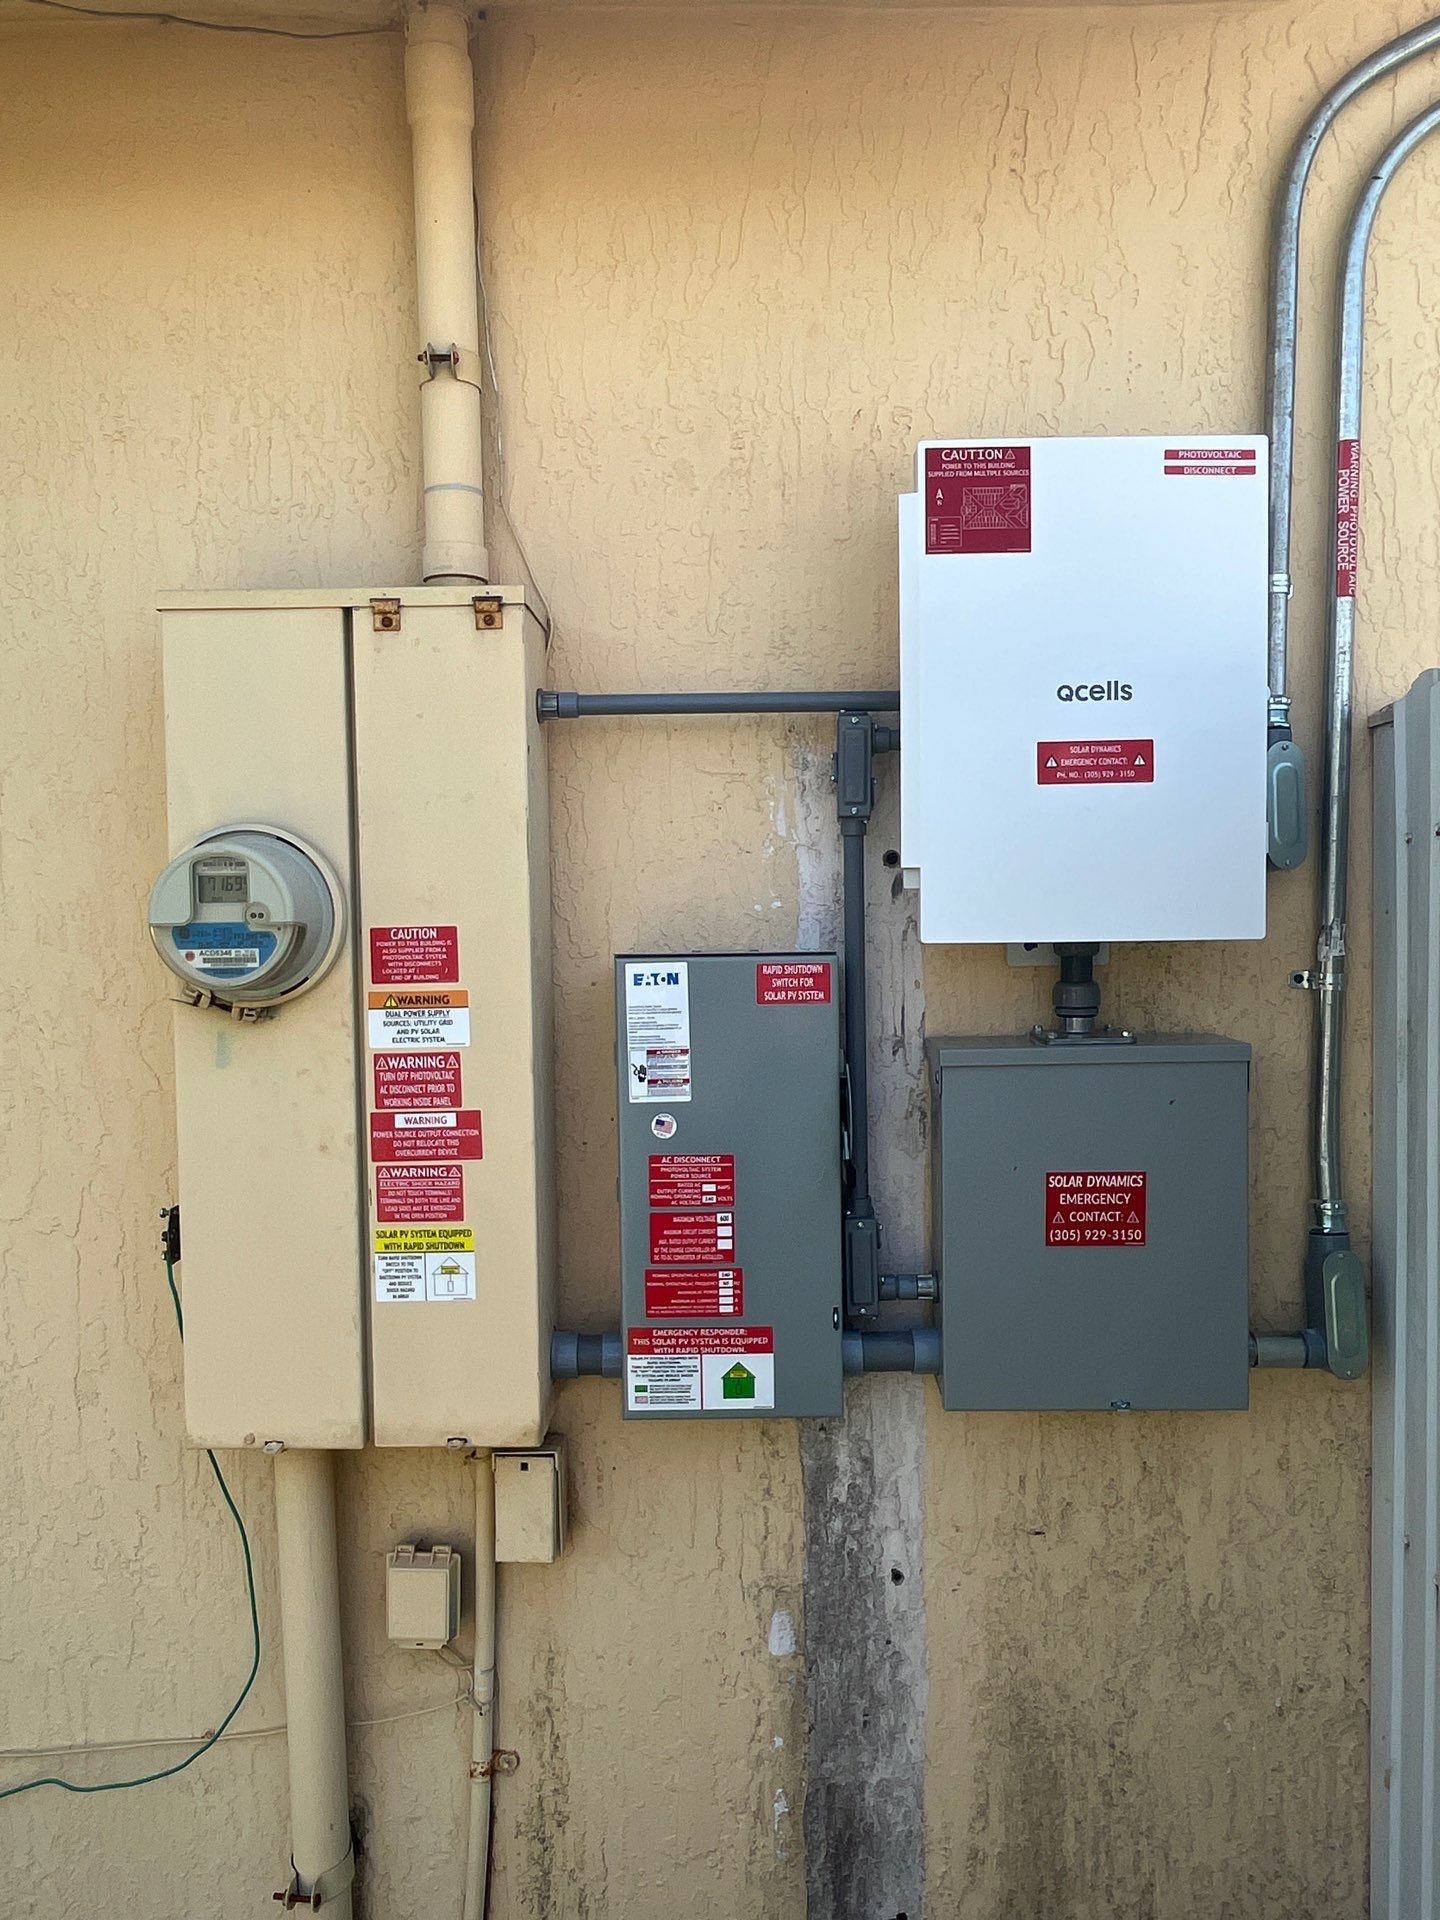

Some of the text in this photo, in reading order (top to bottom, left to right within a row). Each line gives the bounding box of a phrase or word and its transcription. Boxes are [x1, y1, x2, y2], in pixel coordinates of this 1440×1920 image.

[942, 450, 1002, 460] CAUTION
[1337, 470, 1350, 570] POWER SOURCE
[1349, 506, 1359, 594] PHOTOVOLTAIC
[1057, 681, 1132, 702] Qcells
[1091, 745, 1121, 753] DYNAMICS
[1061, 758, 1097, 766] EMERGENCY
[391, 928, 436, 940] CAUTION
[763, 965, 823, 974] RAPID SHUTDOWN
[772, 978, 813, 987] SWITCH FOR
[397, 995, 450, 1005] WARNING
[764, 991, 824, 1000] SOLAR PV SYSTEM
[388, 1056, 445, 1069] WARNING
[380, 1071, 454, 1081] TURN OFF PHOTOVOLTAIC
[380, 1084, 455, 1094] AC DISCONNECT PRIOR TO
[384, 1098, 412, 1106] WORKING
[414, 1098, 431, 1106] INSIDE
[404, 1116, 447, 1124] WARNING
[390, 1168, 447, 1177] WARNING
[1048, 1175, 1143, 1187] SOLAR DYNAMICS
[1060, 1194, 1131, 1204] EMERGENCY
[1070, 1212, 1123, 1222] CONTACT:
[376, 1229, 472, 1239] SOLAR PV SYSTEM EQUIPPED
[1050, 1230, 1080, 1242] (305)
